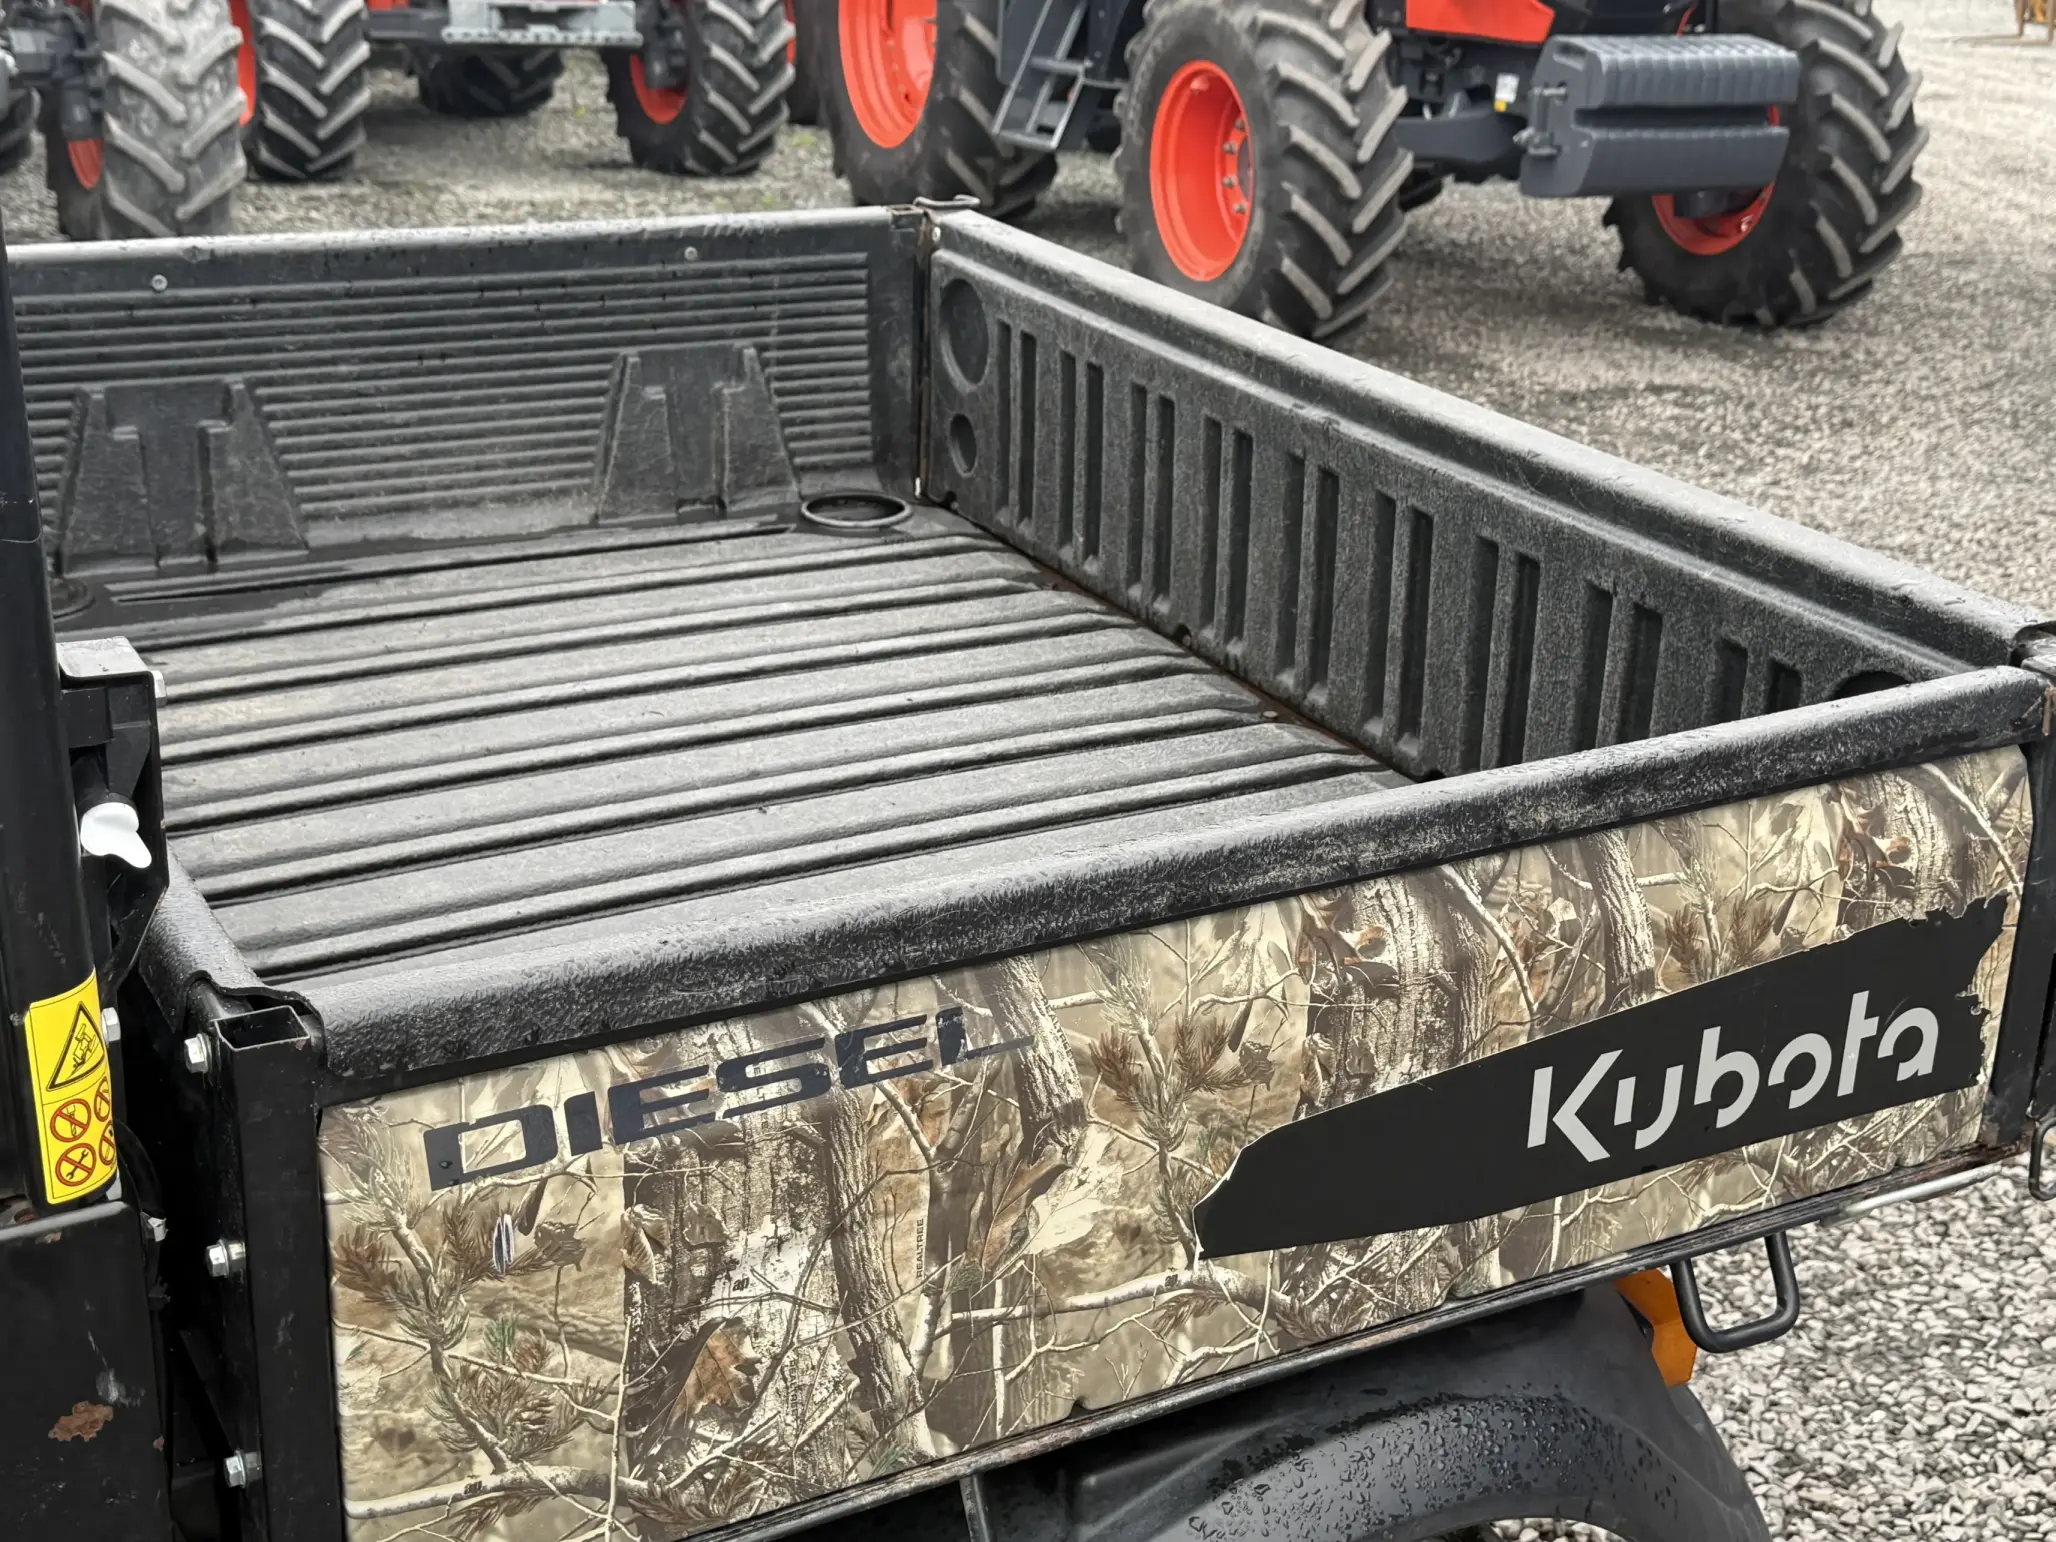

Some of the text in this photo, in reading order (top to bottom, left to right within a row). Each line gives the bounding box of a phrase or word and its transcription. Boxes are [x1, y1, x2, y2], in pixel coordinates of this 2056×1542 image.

[423, 1006, 1035, 1191] DIESEL
[1527, 989, 1940, 1163] Kubota
[916, 1218, 925, 1279] REALTREE
